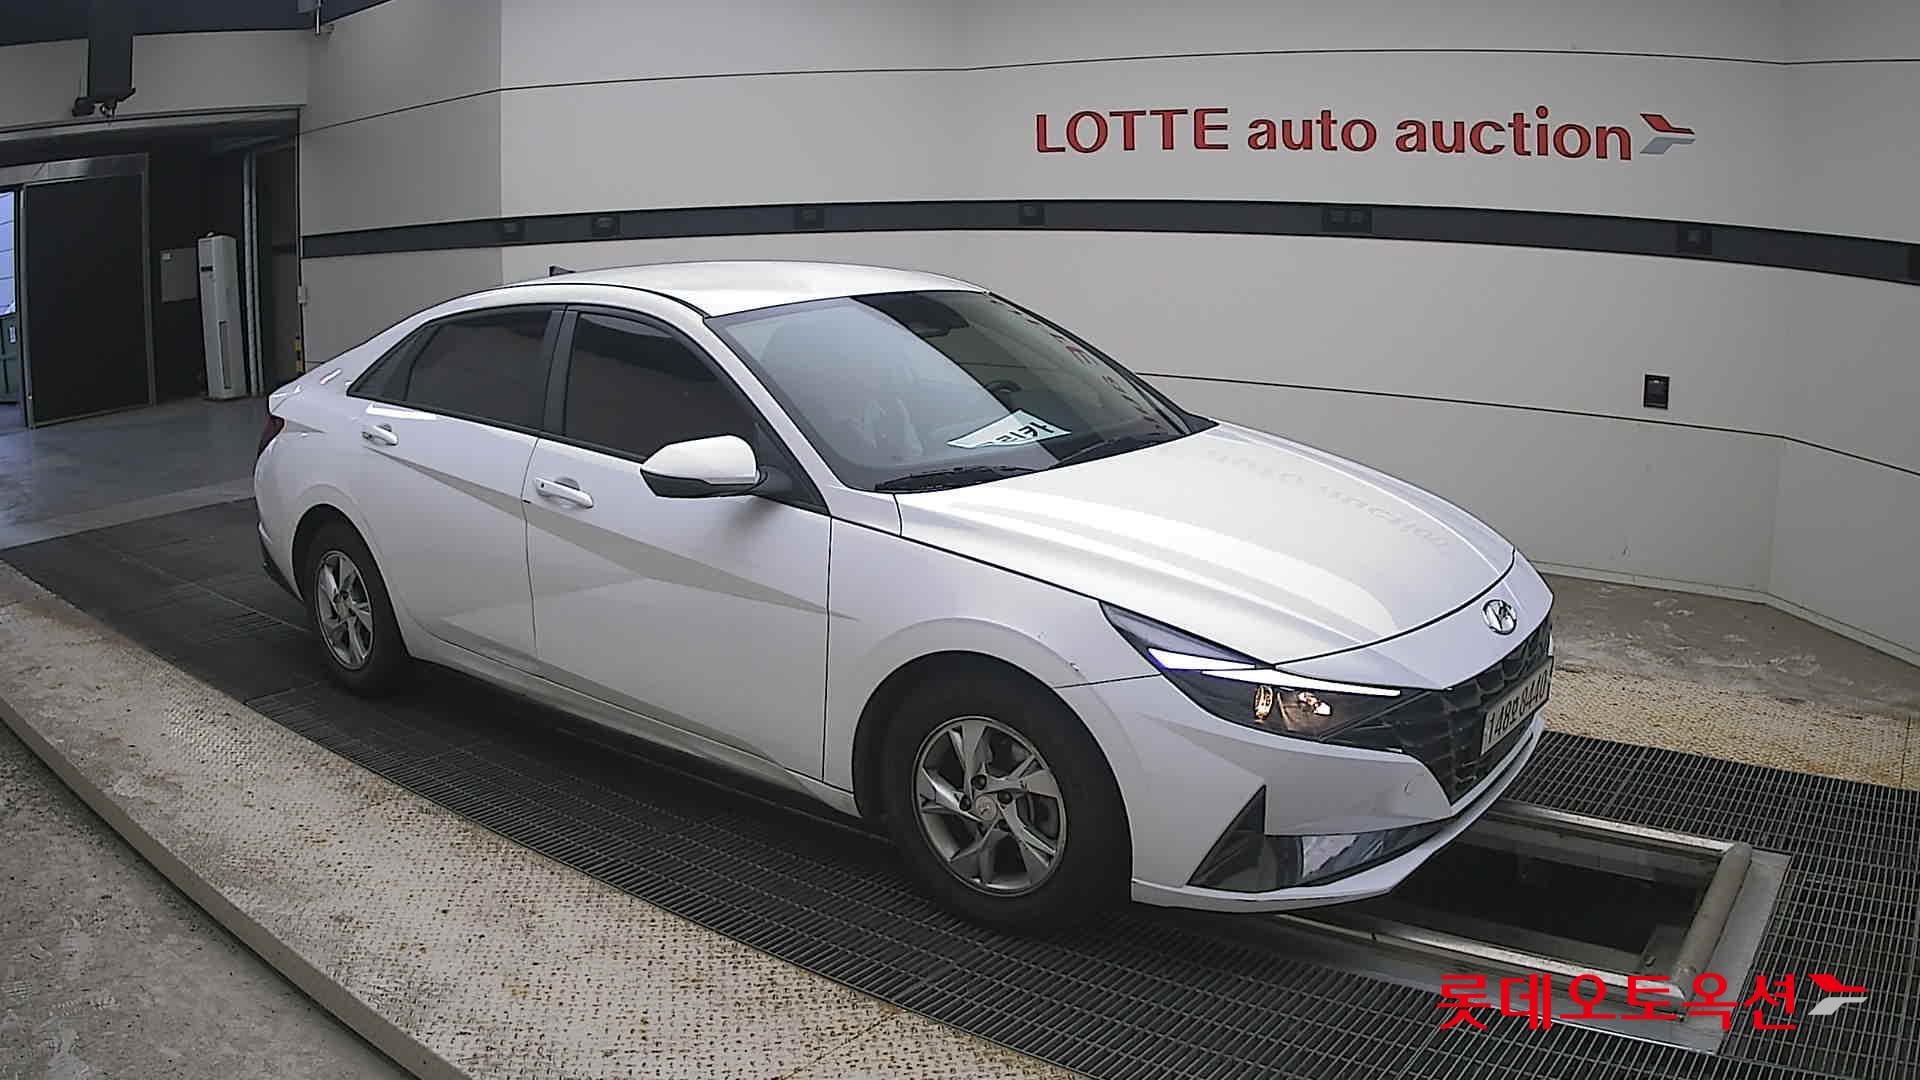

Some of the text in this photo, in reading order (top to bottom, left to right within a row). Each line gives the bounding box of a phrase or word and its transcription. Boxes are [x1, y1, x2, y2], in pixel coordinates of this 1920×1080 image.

[1036, 105, 1632, 161] LOTTE auto auction
